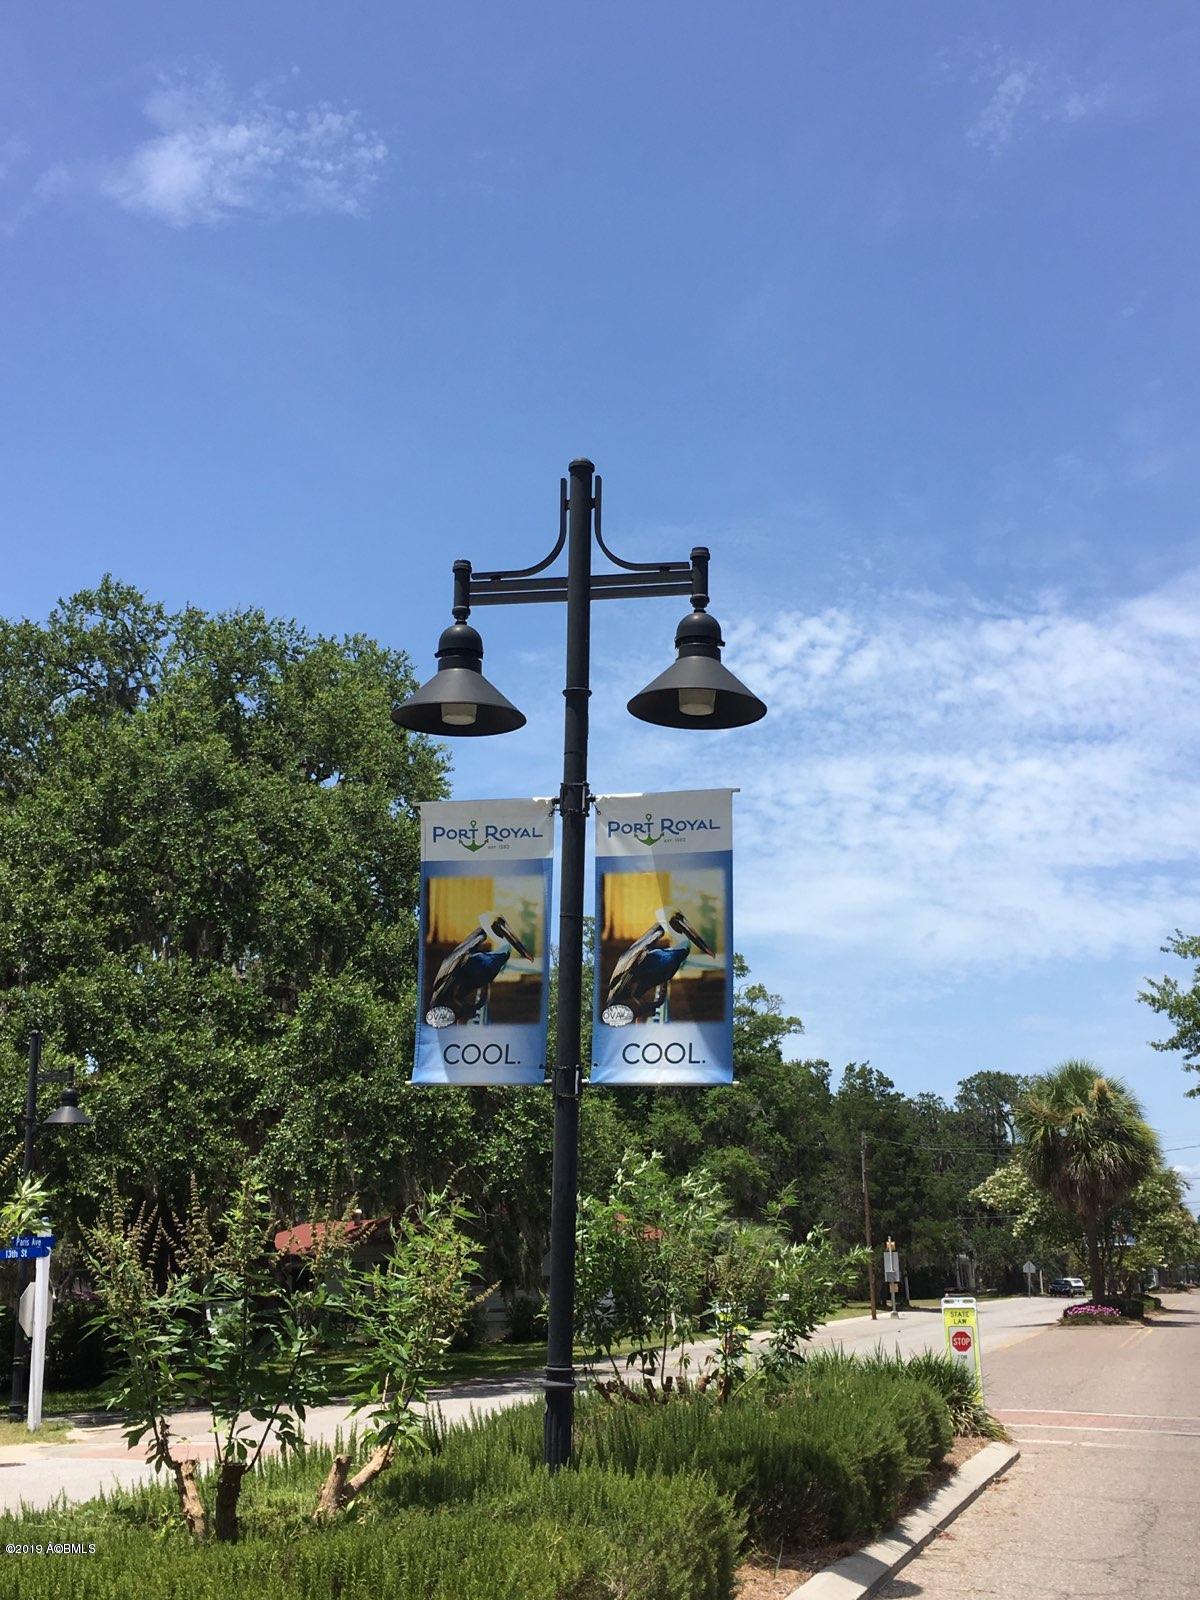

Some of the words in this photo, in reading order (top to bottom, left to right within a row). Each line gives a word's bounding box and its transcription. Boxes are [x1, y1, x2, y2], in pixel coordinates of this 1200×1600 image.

[443, 1043, 521, 1065] COOL.
[622, 1042, 706, 1065] COOL.
[16, 1237, 29, 1247] Paris
[31, 1238, 42, 1247] Ave
[5, 1249, 18, 1259] 13th
[21, 1248, 28, 1257] St
